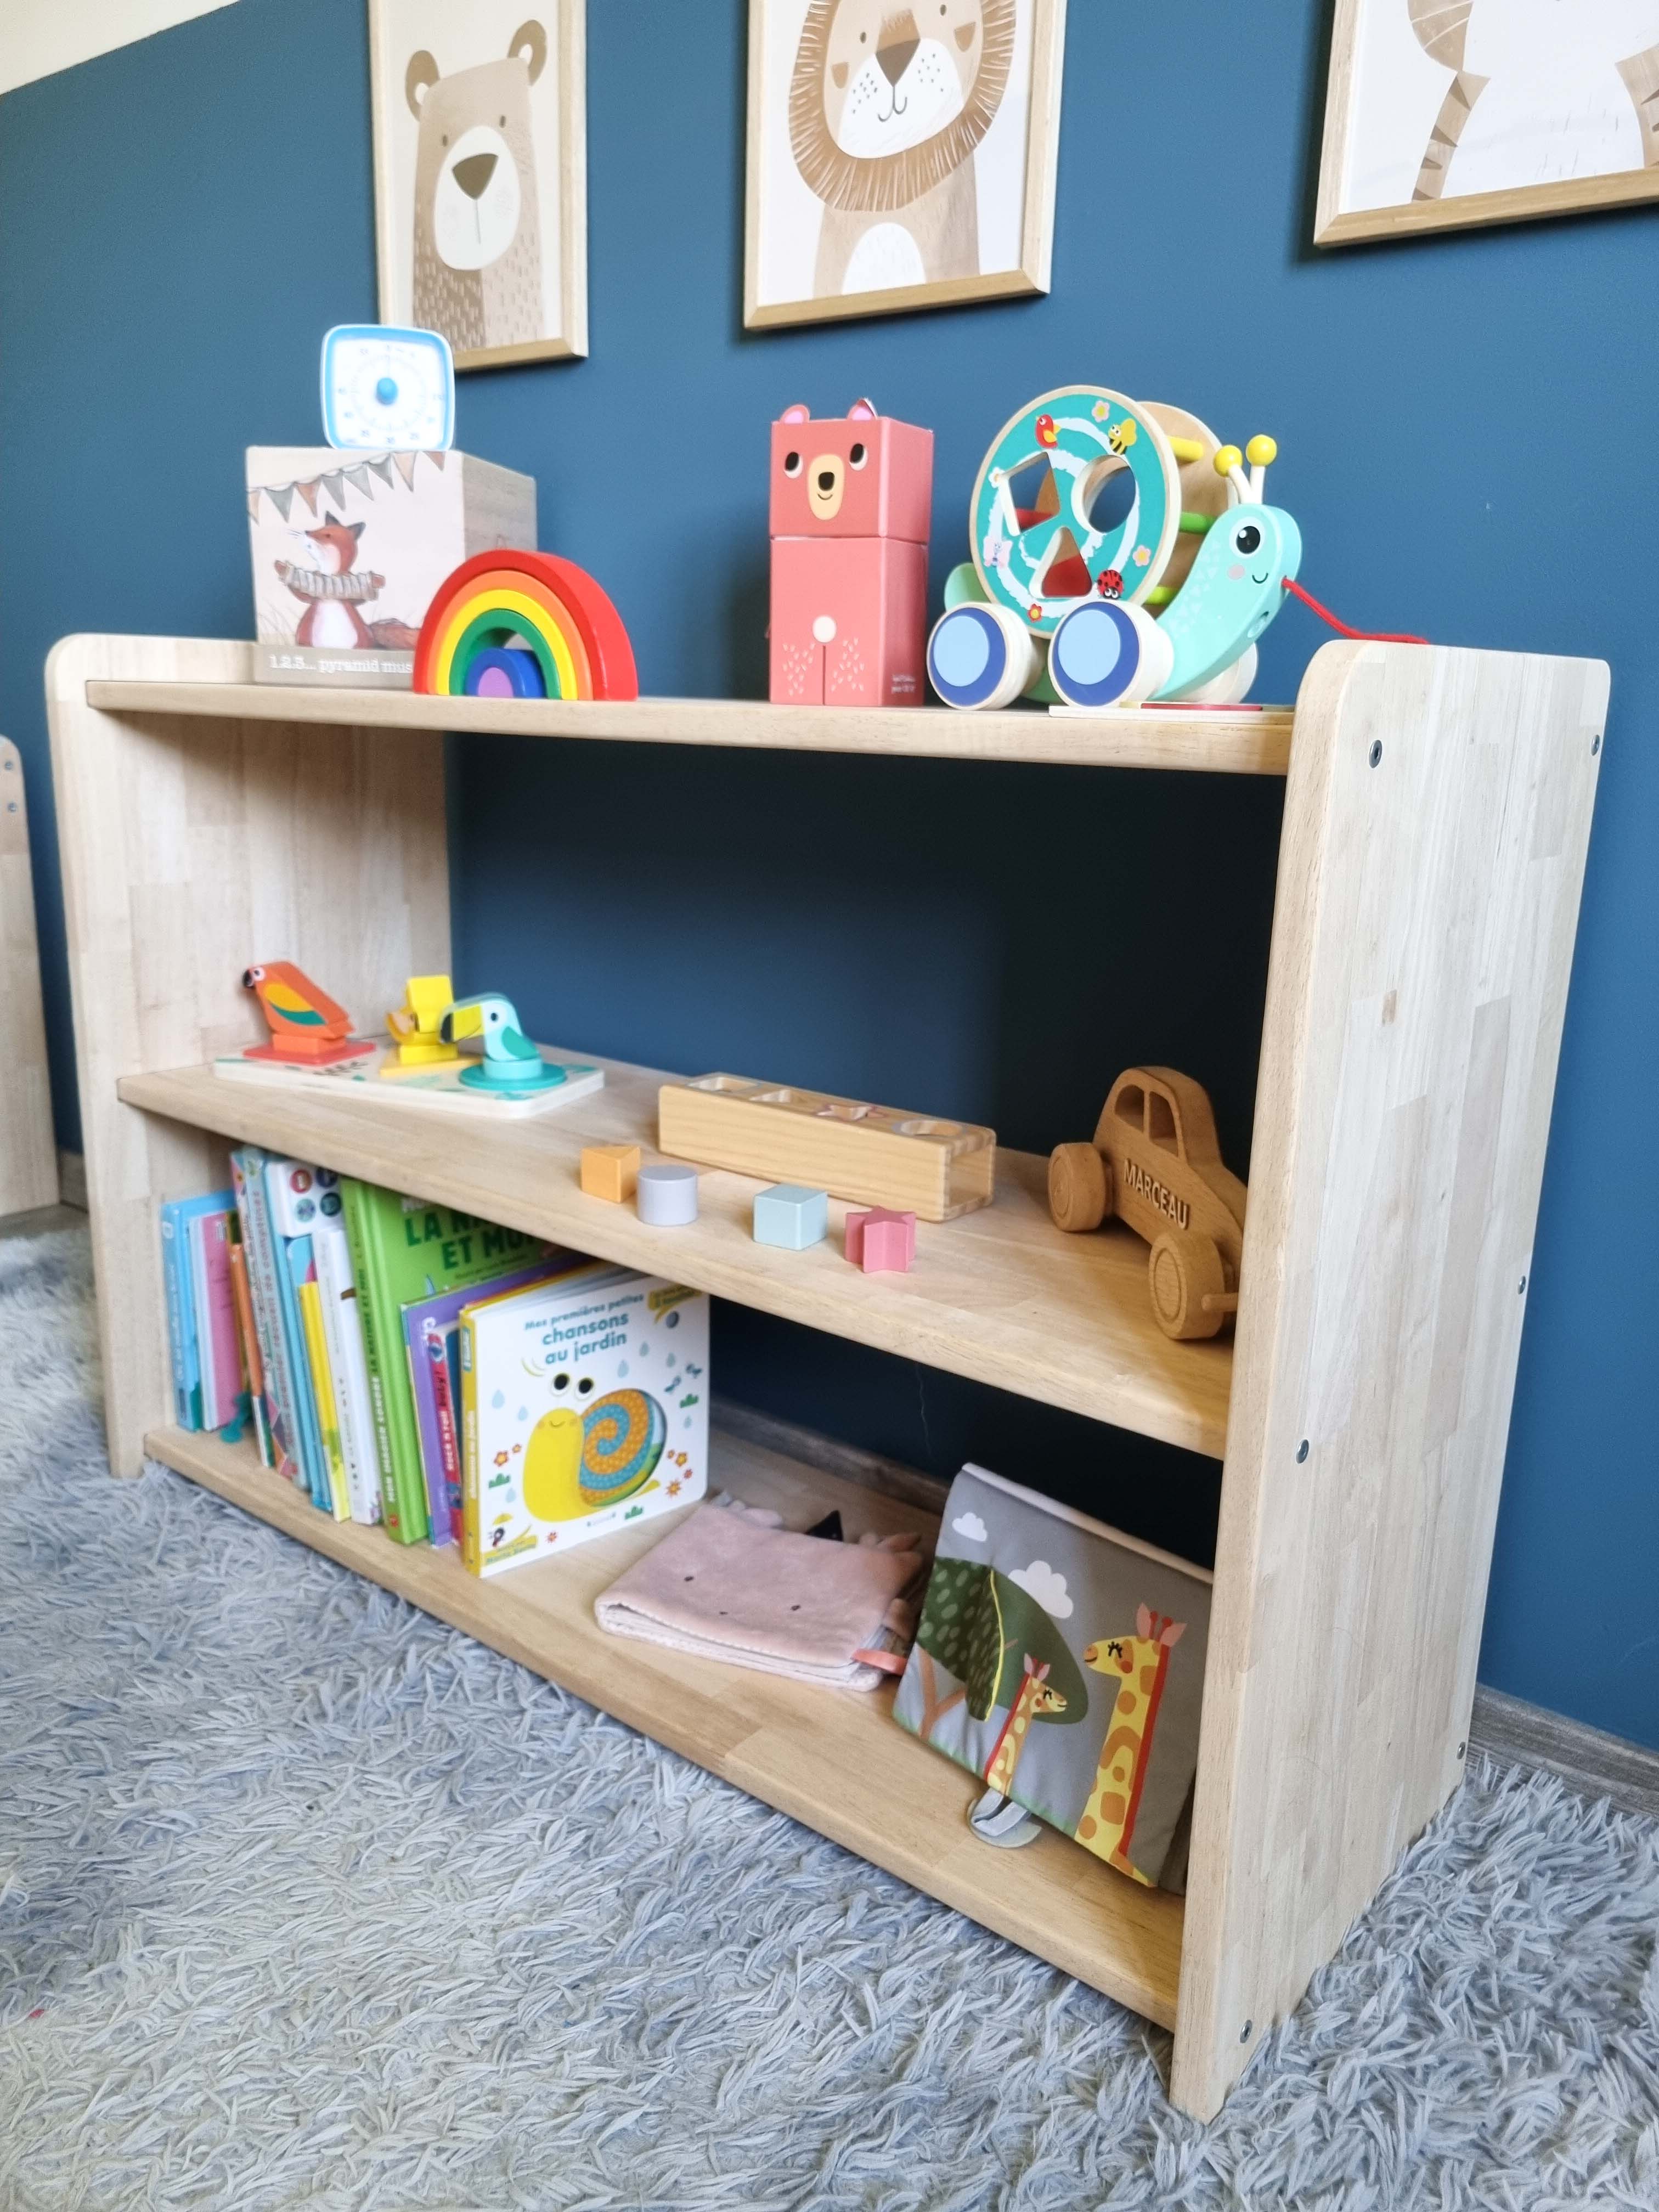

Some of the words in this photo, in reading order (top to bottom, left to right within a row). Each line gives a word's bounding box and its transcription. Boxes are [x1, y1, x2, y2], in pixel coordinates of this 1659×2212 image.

[1124, 1158, 1190, 1230] MARCEAU
[253, 1190, 270, 1269] comptines
[405, 1211, 443, 1246] LA
[442, 1235, 472, 1271] ET
[524, 1319, 548, 1330] Mes
[550, 1304, 606, 1325] premières
[607, 1294, 644, 1312] petites
[542, 1313, 629, 1345] chansons
[545, 1349, 568, 1364] au
[574, 1331, 627, 1362] jardin
